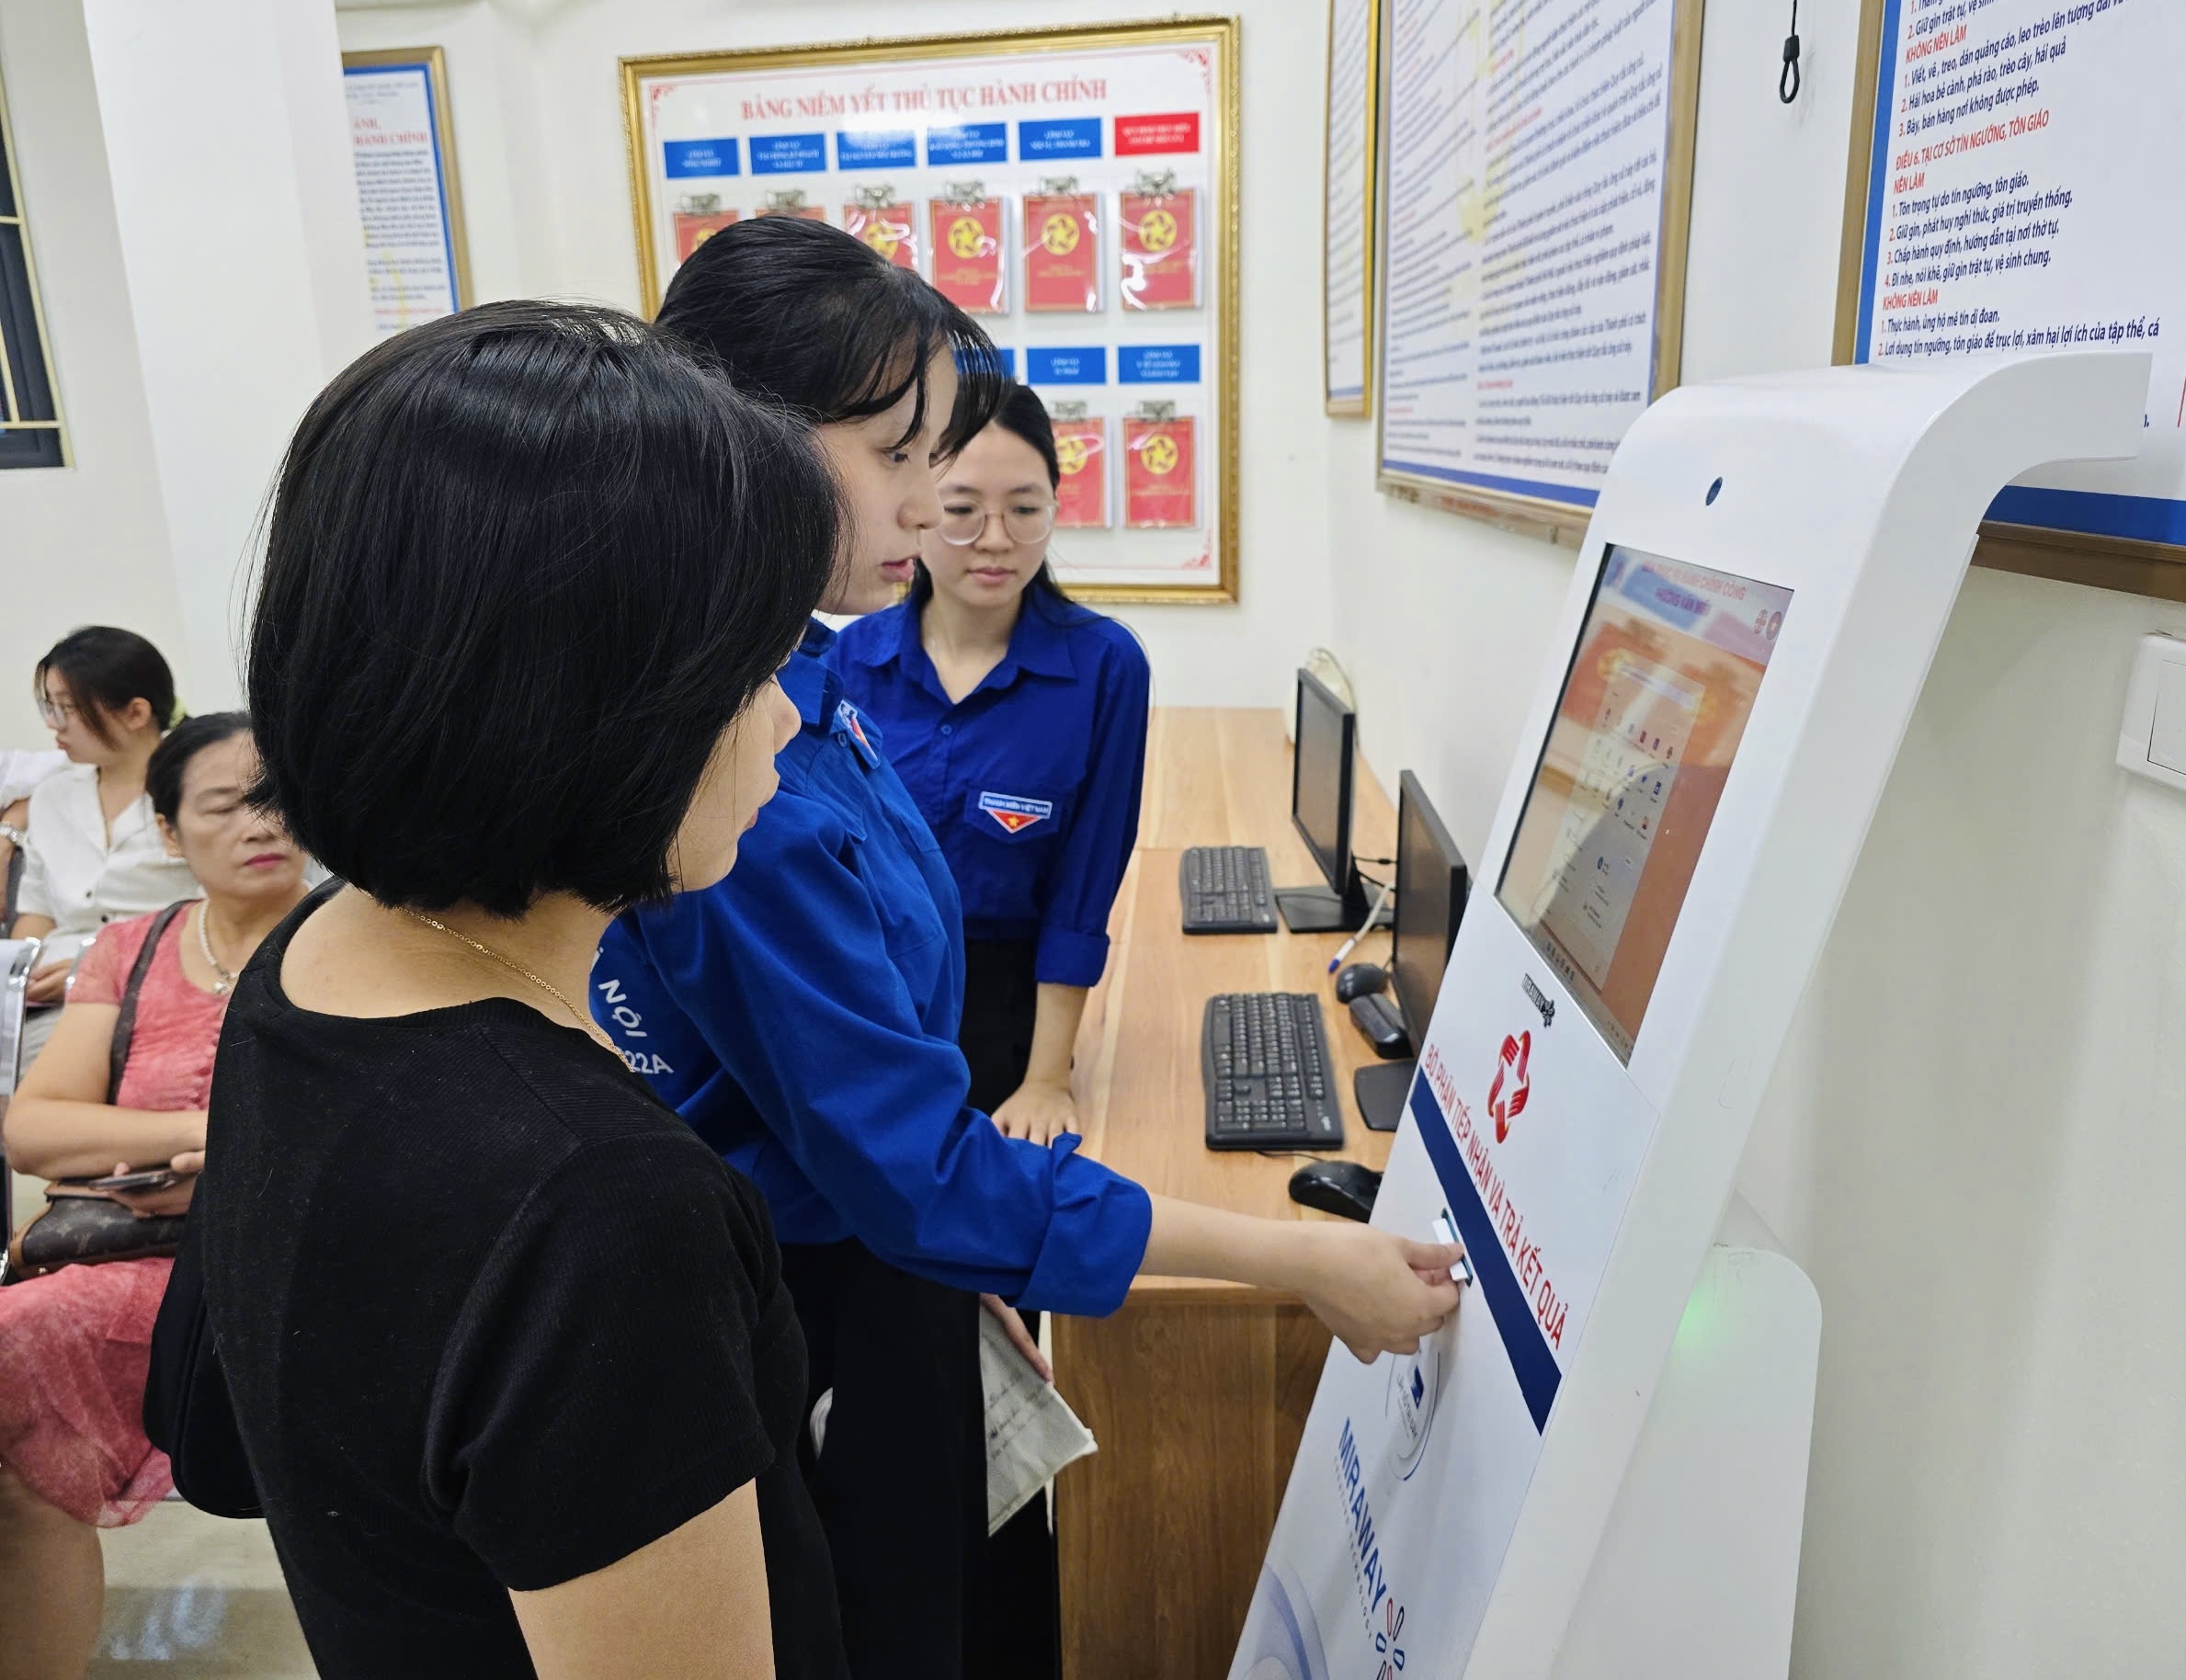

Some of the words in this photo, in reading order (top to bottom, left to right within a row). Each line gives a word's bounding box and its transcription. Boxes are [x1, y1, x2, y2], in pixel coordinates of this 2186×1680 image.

[1904, 74, 1910, 88] 1.
[1941, 58, 1957, 74] treo,
[1959, 49, 1974, 67] dán
[1975, 40, 2000, 64] quảng
[2000, 31, 2017, 51] cáo,
[2018, 27, 2031, 44] leo
[2032, 17, 2050, 39] trèo
[2051, 12, 2066, 31] lên
[2067, 2, 2095, 26] tượng
[1906, 40, 1932, 64] KHÔNG
[1933, 30, 1949, 52] NÊN
[1950, 23, 1967, 45] LÀM
[1907, 25, 1915, 40] 2.
[741, 93, 791, 120] BẢNG
[937, 85, 978, 115] TỤC
[980, 78, 1035, 108] HÀNH
[1041, 74, 1108, 103] CHÍNH
[1901, 99, 1907, 113] 2.
[1922, 90, 1935, 105] hoa
[1967, 66, 1982, 93] phá
[1983, 65, 1998, 84] rào,
[1999, 58, 2016, 77] trèo
[2017, 51, 2033, 73] cây,
[2034, 42, 2049, 64] hái
[2049, 35, 2066, 63] quả
[1898, 123, 1906, 137] 3.
[1921, 110, 1936, 130] bán
[1936, 106, 1955, 125] hàng
[1956, 99, 1968, 117] nơi
[1969, 93, 1994, 114] không
[1995, 85, 2015, 107] được
[2015, 76, 2040, 101] phép.
[1896, 150, 1914, 172] ĐIỀU
[1914, 151, 1920, 166] 6.
[1920, 142, 1932, 167] TẠI
[1932, 140, 1945, 160] CƠ
[1944, 135, 1957, 157] SỞ
[1956, 133, 1968, 154] TÍN
[1969, 123, 2007, 150] NGƯỠNG,
[2009, 112, 2026, 138] TÔN
[2027, 108, 2050, 132] GIÁO
[1892, 204, 1898, 218] 1.
[1898, 201, 1910, 216] Tôn
[1911, 199, 1930, 216] trọng
[1931, 193, 1941, 212] tự
[1941, 189, 1950, 205] do
[1951, 187, 1961, 204] tín
[1962, 182, 1993, 204] ngưỡng,
[1995, 176, 2008, 194] tôn
[2009, 170, 2029, 195] giáo.
[1893, 175, 1908, 195] NÊN
[1908, 171, 1925, 191] LÀM
[1889, 228, 1896, 242] 2.
[1896, 223, 1908, 240] Giữ
[1908, 221, 1921, 241] gìn,
[1922, 219, 1939, 239] phát
[1940, 215, 1954, 233] huy
[1954, 209, 1972, 231] nghi
[1972, 206, 1990, 224] thức,
[1992, 200, 2005, 224] giá
[2006, 199, 2016, 221] trị
[2044, 185, 2073, 209] thống.
[1886, 251, 1893, 266] 3.
[1894, 244, 1911, 266] Chấp
[1911, 243, 1930, 261] hành
[1930, 244, 1944, 261] quy
[1944, 235, 1963, 258] định,
[1963, 233, 1987, 252] hướng
[1989, 226, 2004, 246] dẫn
[2005, 225, 2017, 247] tại
[2017, 221, 2032, 241] nơi
[2032, 219, 2048, 239] thờ
[2047, 218, 2060, 240] tự.
[1884, 274, 1891, 288] 4.
[1891, 272, 1899, 287] Đi
[1899, 269, 1914, 289] nhẹ,
[1915, 267, 1927, 283] nói
[1942, 262, 1955, 283] giữ
[1955, 260, 1967, 281] gìn
[1968, 258, 1983, 278] trật
[1983, 257, 1994, 277] tự,
[1995, 253, 2004, 275] vệ
[2005, 250, 2022, 269] sinh
[2023, 248, 2051, 267] chung.
[1882, 293, 1907, 311] KHÔNG
[1907, 289, 1922, 307] NÊN
[1922, 287, 1939, 305] LÀM
[1887, 318, 1903, 335] Thực
[1903, 314, 1921, 333] hành,
[1922, 312, 1936, 333] ủng
[1936, 312, 1946, 331] hộ
[1947, 312, 1960, 326] mê
[1960, 309, 1969, 325] tín
[1970, 308, 1978, 328] dị
[1978, 306, 2000, 324] đoan.
[1878, 343, 1884, 357] 2.
[1896, 339, 1913, 358] dụng
[1913, 338, 1923, 354] tín
[1923, 336, 1952, 357] ngưỡng,
[1953, 335, 1965, 351] tôn
[1966, 332, 1983, 354] giáo
[1984, 330, 1996, 348] để
[1996, 333, 2011, 352] trục
[2011, 329, 2024, 350] lợi,
[2025, 328, 2044, 346] xâm
[2045, 325, 2061, 348] hại
[2060, 324, 2074, 347] lợi
[2074, 323, 2088, 343] ích
[2089, 322, 2106, 341] của
[2108, 321, 2124, 345] tập
[2126, 315, 2146, 340] thể,
[2147, 316, 2160, 337] cá
[598, 979, 648, 1038] NỘI
[618, 1046, 674, 1074] 22A
[1425, 1043, 1440, 1080] BỘ
[1434, 1072, 1456, 1113] PHẬN
[1451, 1102, 1472, 1149] TIẾP
[1466, 1129, 1494, 1196] NHẬN
[1488, 1174, 1506, 1220] VÀ
[1498, 1197, 1524, 1257] TRẢ
[1516, 1236, 1543, 1296] KẾT
[1537, 1278, 1568, 1350] QUẢ
[1338, 1416, 1387, 1613] MIRAWAY
